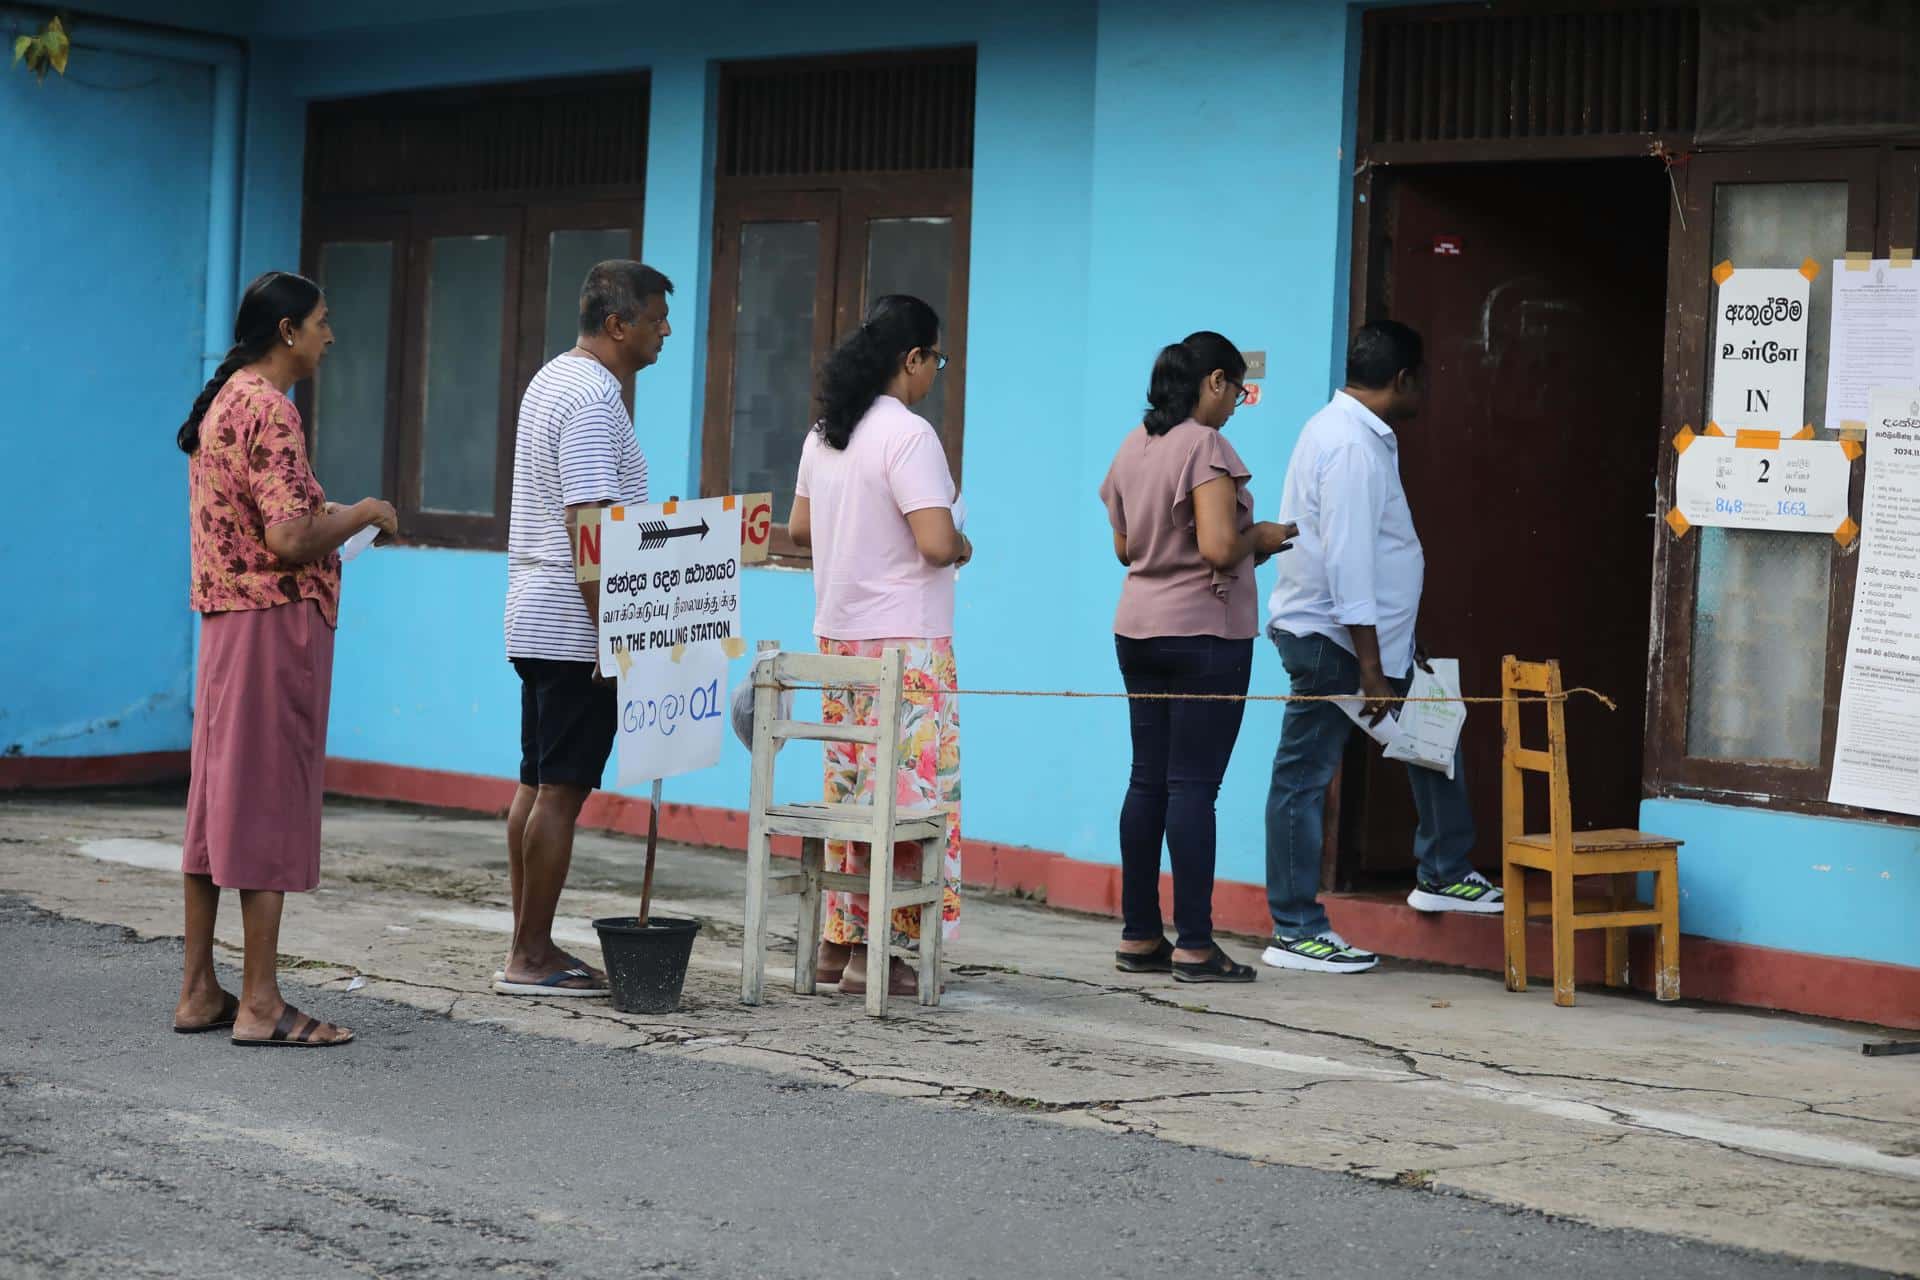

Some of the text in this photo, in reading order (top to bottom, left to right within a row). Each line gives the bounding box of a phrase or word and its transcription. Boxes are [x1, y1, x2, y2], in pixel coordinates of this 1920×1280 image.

[1725, 297, 1803, 327] ඇතුල්වීම
[1722, 340, 1800, 364] உள்ளே
[1745, 389, 1770, 413] IN
[1757, 459, 1771, 483] 2
[1715, 497, 1744, 515] 848
[606, 571, 647, 597] ඡන්දය
[653, 567, 680, 593] දෙන
[603, 599, 669, 624] வாக்கெடுப்பு
[609, 620, 731, 655] TO THE POLLING STATION
[690, 678, 722, 721] 01
